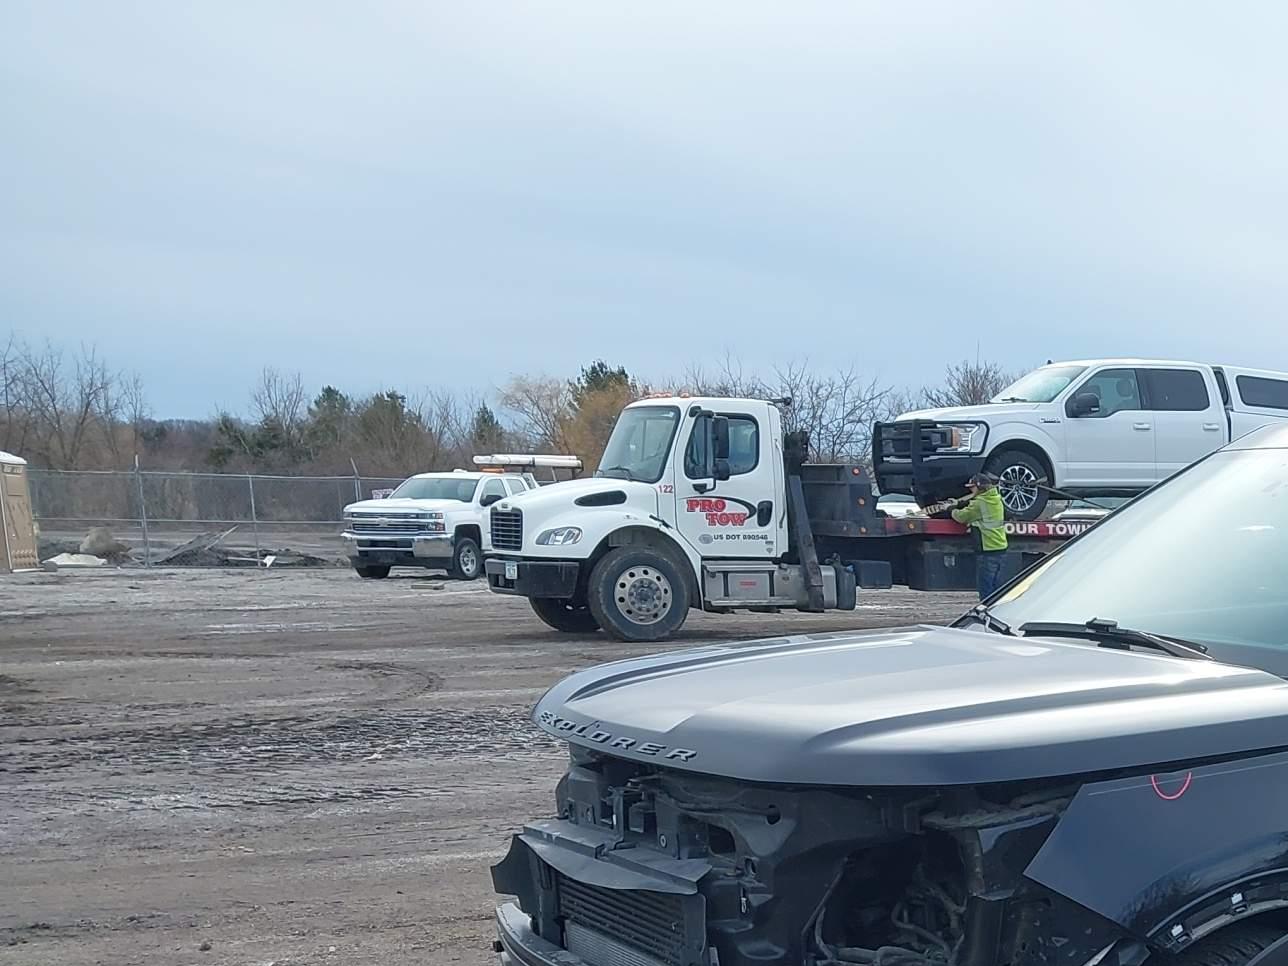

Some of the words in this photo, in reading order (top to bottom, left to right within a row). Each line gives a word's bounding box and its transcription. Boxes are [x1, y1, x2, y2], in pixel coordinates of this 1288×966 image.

[686, 499, 727, 512] PRO
[705, 512, 748, 526] TOW
[1003, 522, 1039, 535] OUR
